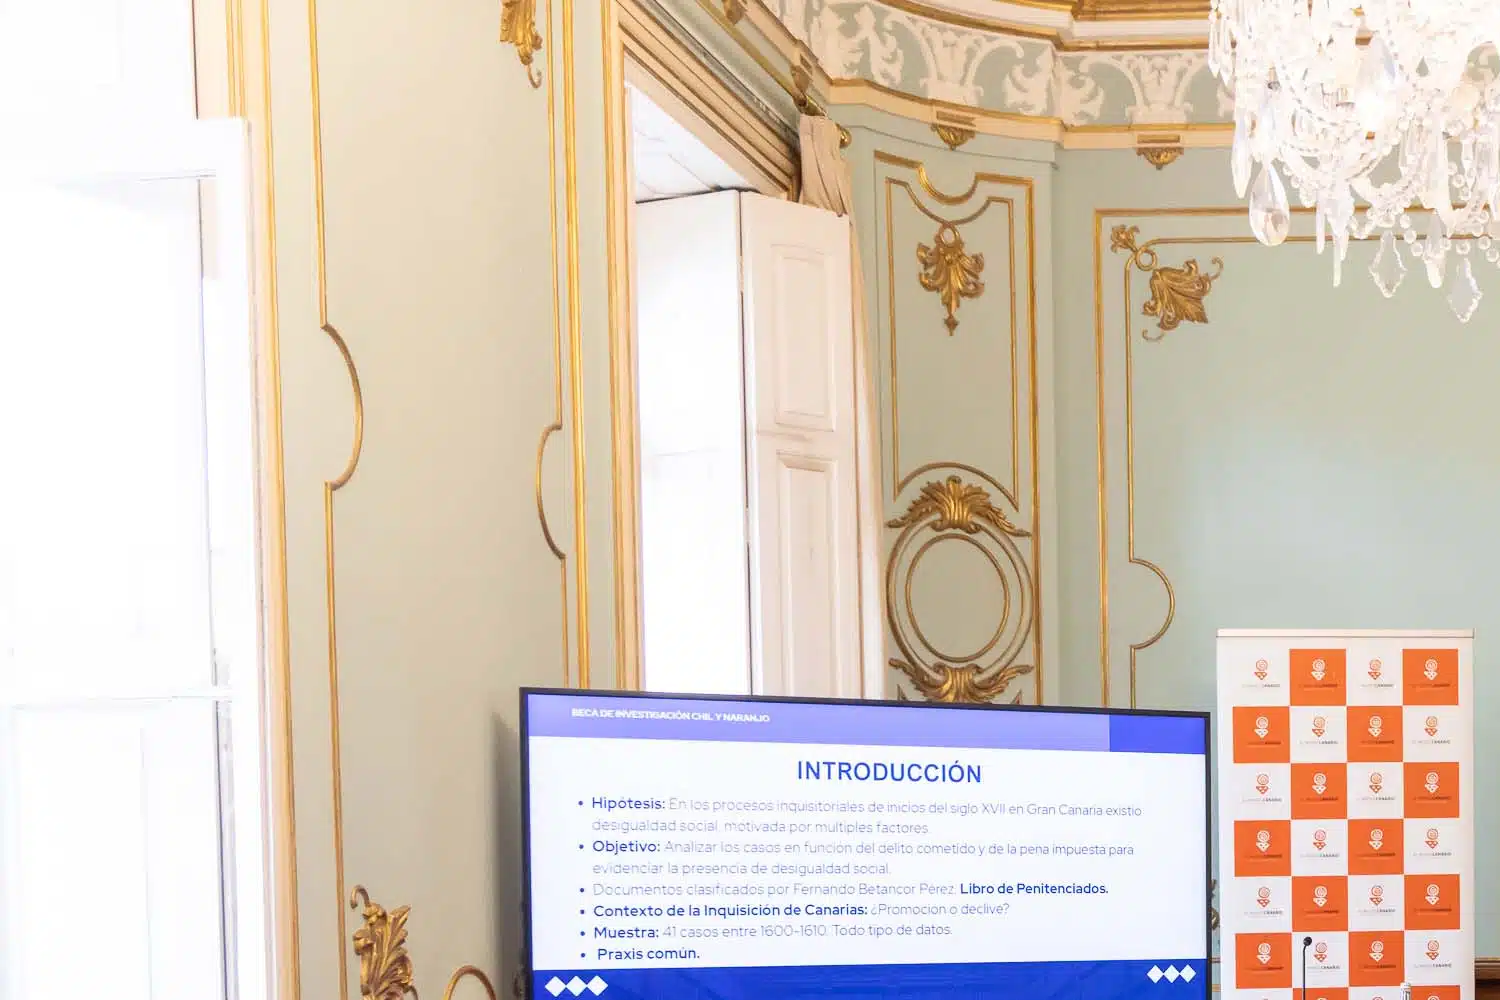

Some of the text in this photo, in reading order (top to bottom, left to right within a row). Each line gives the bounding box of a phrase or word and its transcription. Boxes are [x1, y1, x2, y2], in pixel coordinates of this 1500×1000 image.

[572, 708, 597, 718] BECA
[599, 709, 615, 718] DE
[714, 712, 722, 721] Y
[723, 712, 770, 722] NARANJO
[799, 760, 980, 782] INTRODUCCIÓN
[669, 798, 686, 809] En
[691, 800, 709, 810] los
[713, 800, 773, 814] procesos
[777, 800, 864, 815] inquisitoriales
[868, 801, 884, 812] de
[887, 802, 926, 813] inicios
[929, 802, 947, 813] del
[951, 803, 978, 816] siglo
[982, 802, 1005, 814] XVII
[1009, 804, 1023, 814] en
[1027, 804, 1055, 815] Gran
[1059, 804, 1102, 815] Canaria
[592, 819, 676, 833] desigualdad
[725, 822, 785, 832] motivada
[788, 824, 812, 834] por
[593, 841, 660, 855] Objetivo:
[664, 841, 717, 852] Analizar
[721, 842, 740, 853] los
[744, 844, 780, 853] casos
[856, 842, 874, 856] del
[879, 843, 913, 854] delito
[917, 843, 975, 854] cometido
[978, 845, 985, 856] y
[989, 844, 1004, 854] de
[1008, 844, 1016, 854] la
[1020, 846, 1049, 857] pena
[1053, 844, 1106, 857] impuesta
[1109, 847, 1133, 857] para
[593, 863, 663, 874] evidenciar
[668, 863, 678, 873] la
[682, 865, 747, 876] presencia
[751, 864, 767, 874] de
[772, 863, 850, 876] desigualdad
[593, 884, 682, 895] Documentos
[687, 883, 764, 895] clasificados
[768, 886, 789, 897] por
[794, 883, 855, 894] Fernando
[859, 883, 915, 894] Betancor
[961, 883, 994, 894] Libro
[998, 884, 1013, 893] de
[1017, 883, 1108, 894] Penitenciados.
[594, 906, 663, 916] Contexto
[667, 905, 684, 916] de
[689, 905, 700, 916] la
[705, 905, 780, 919] Inquisición
[784, 904, 801, 915] de
[805, 904, 867, 915] Canarias:
[950, 906, 957, 914] o
[961, 903, 1009, 914] declive?
[595, 927, 658, 938] Muestra:
[663, 924, 676, 936] 41
[680, 929, 718, 937] casos
[722, 928, 757, 937] entre
[833, 925, 865, 936] Todo
[868, 926, 893, 938] tipo
[897, 925, 912, 935] de
[916, 924, 952, 935] datos.
[598, 948, 699, 960] Praxis común.
